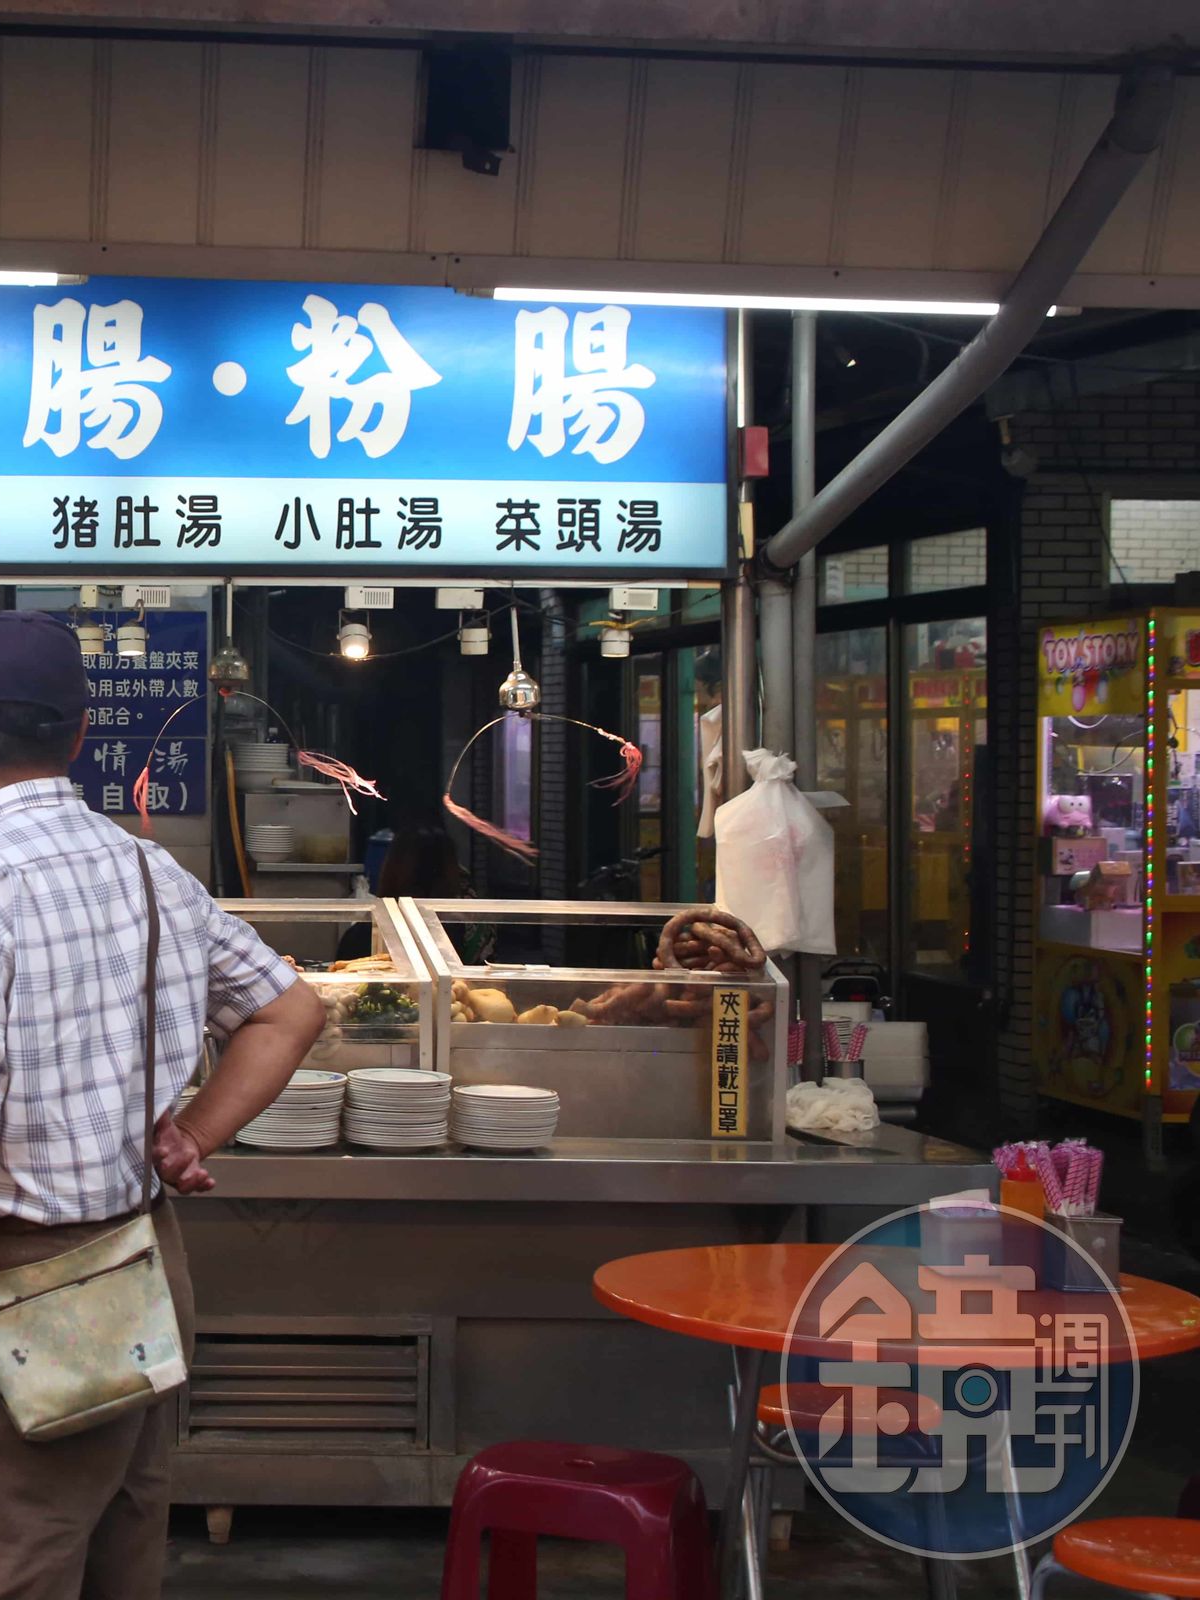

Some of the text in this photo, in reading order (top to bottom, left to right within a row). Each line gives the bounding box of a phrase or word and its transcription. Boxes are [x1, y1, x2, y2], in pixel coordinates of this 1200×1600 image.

[274, 496, 444, 552] 小肚湯
[495, 498, 663, 554] 菜頭湯
[1045, 631, 1139, 673] TOY STORY
[72, 782, 188, 811] 自取)
[717, 992, 740, 1132] 夾菜請戴口罩
